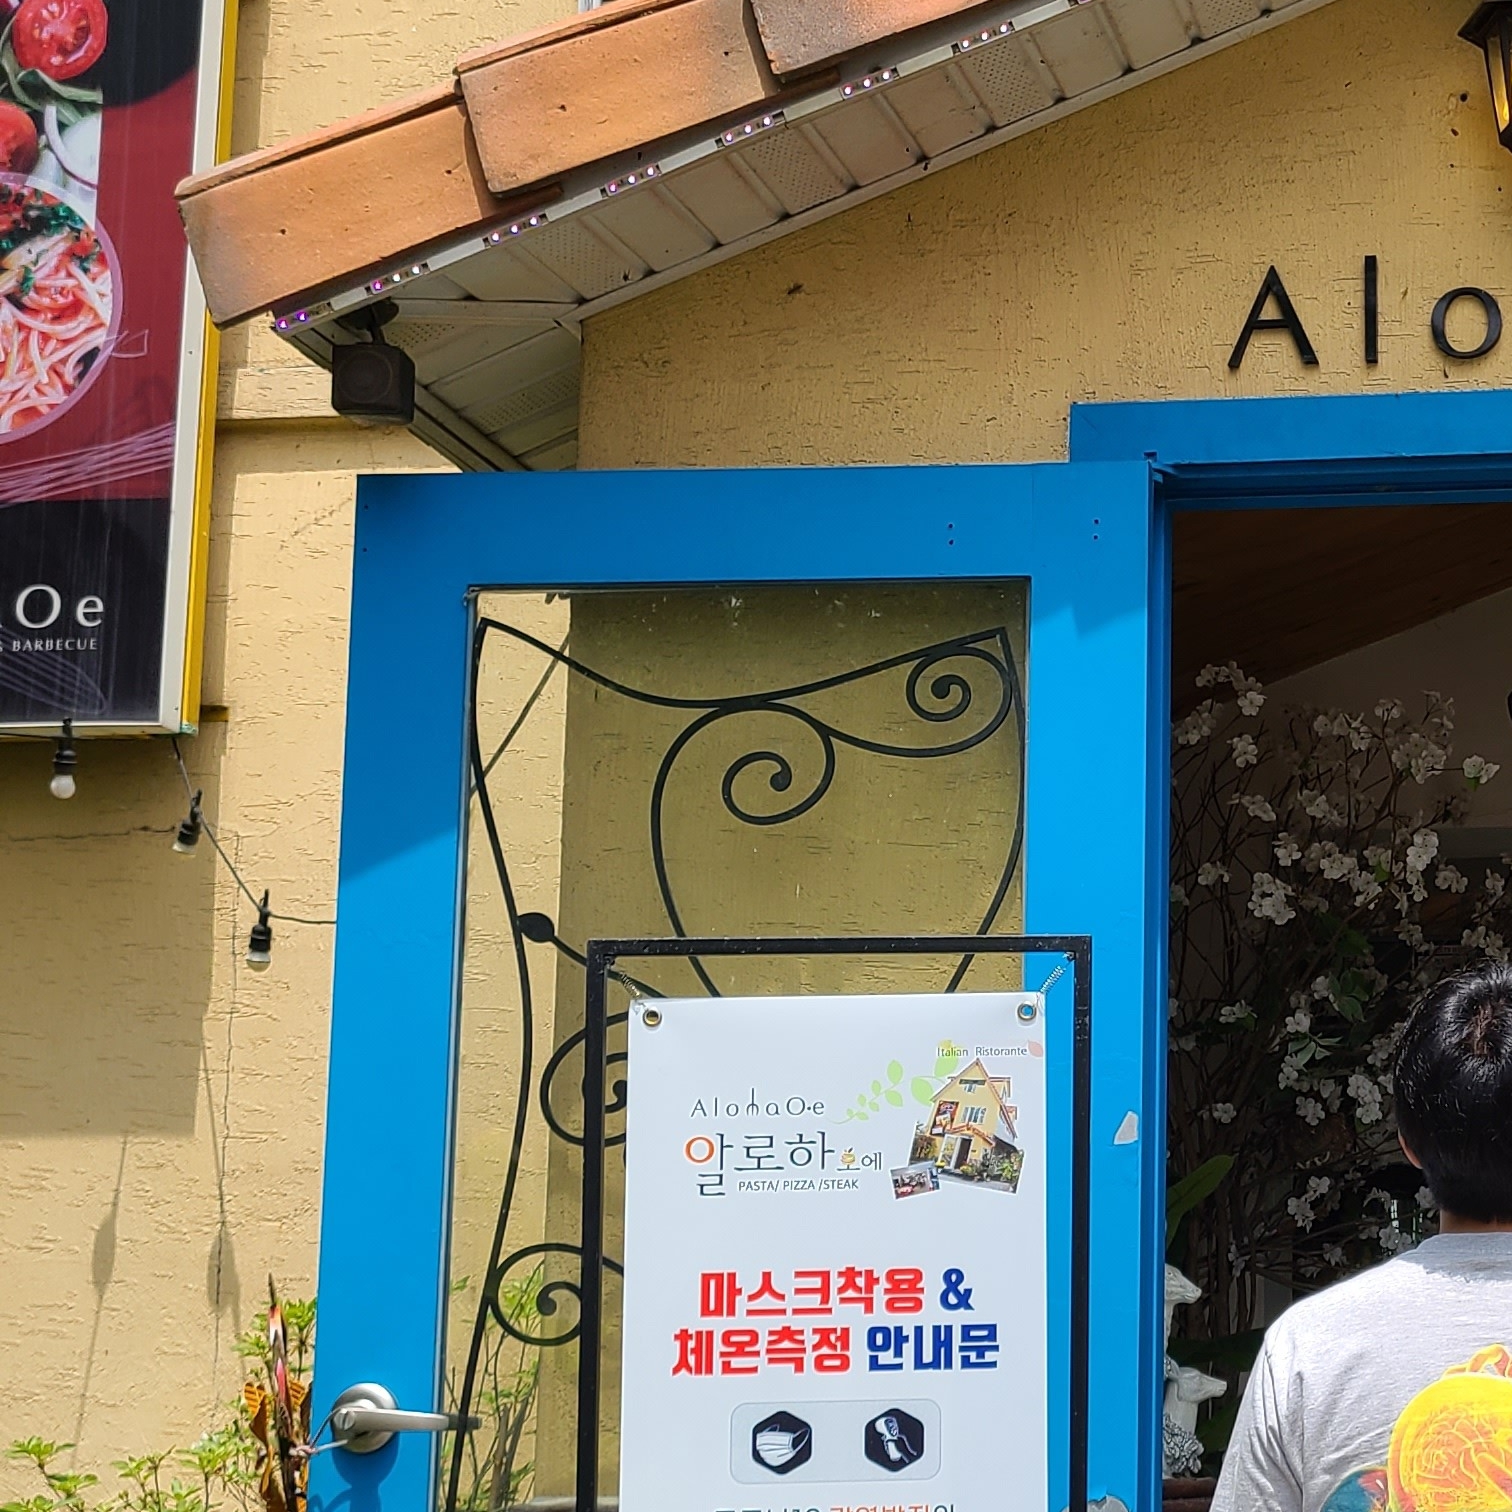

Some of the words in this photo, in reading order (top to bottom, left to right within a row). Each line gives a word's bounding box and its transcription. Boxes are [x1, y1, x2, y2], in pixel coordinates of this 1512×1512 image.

[12, 638, 97, 651] BARBECUE
[937, 1047, 969, 1057] Italian
[975, 1046, 1028, 1056] Ristorante
[700, 1265, 924, 1318] 마스크착용
[938, 1267, 975, 1311] &
[672, 1325, 851, 1377] 체온측정
[866, 1322, 1000, 1373] 안내문
